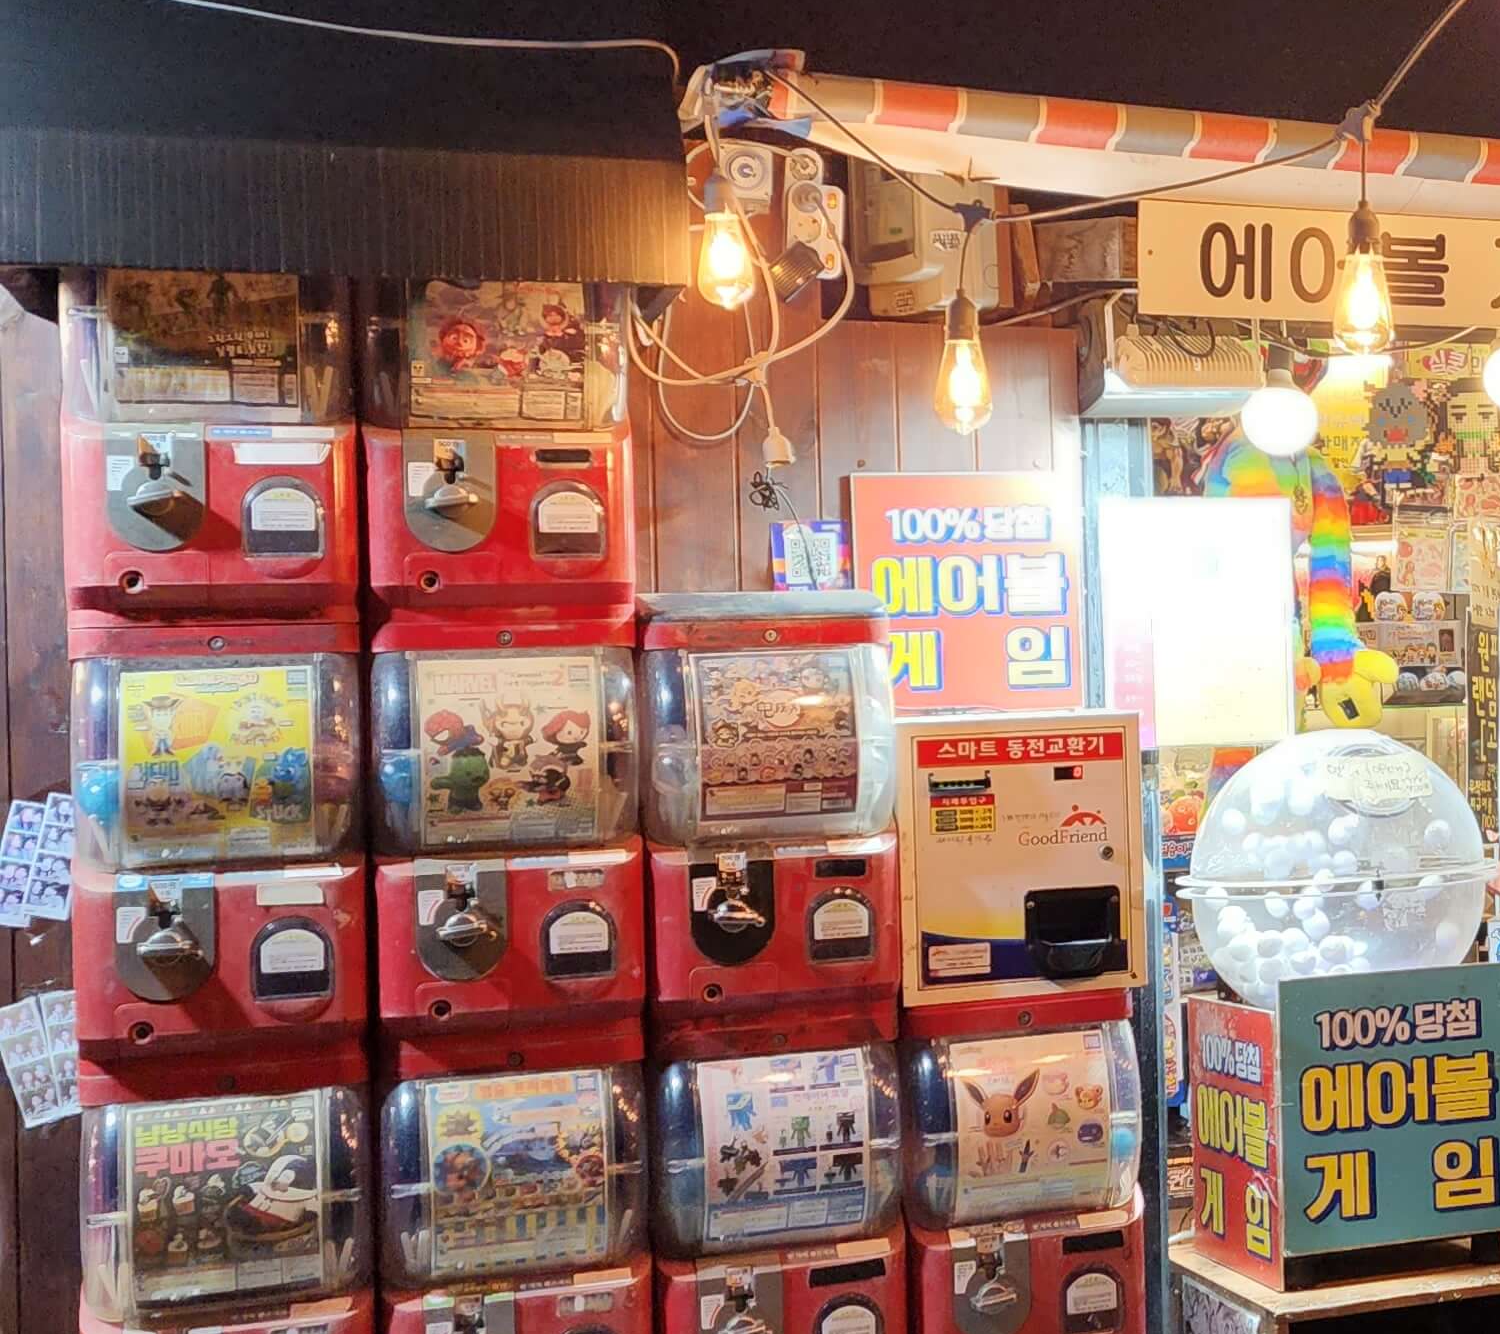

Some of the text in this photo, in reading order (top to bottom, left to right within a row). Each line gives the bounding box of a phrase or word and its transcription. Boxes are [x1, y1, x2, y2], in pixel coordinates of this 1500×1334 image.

[1200, 221, 1450, 308] 에어볼
[871, 553, 1070, 617] 에어볼
[936, 735, 1105, 760] 스마트 동전교환기
[1018, 827, 1108, 847] GoodFriend
[1196, 1079, 1270, 1170] 에어볼
[1299, 1050, 1496, 1136] 에어볼
